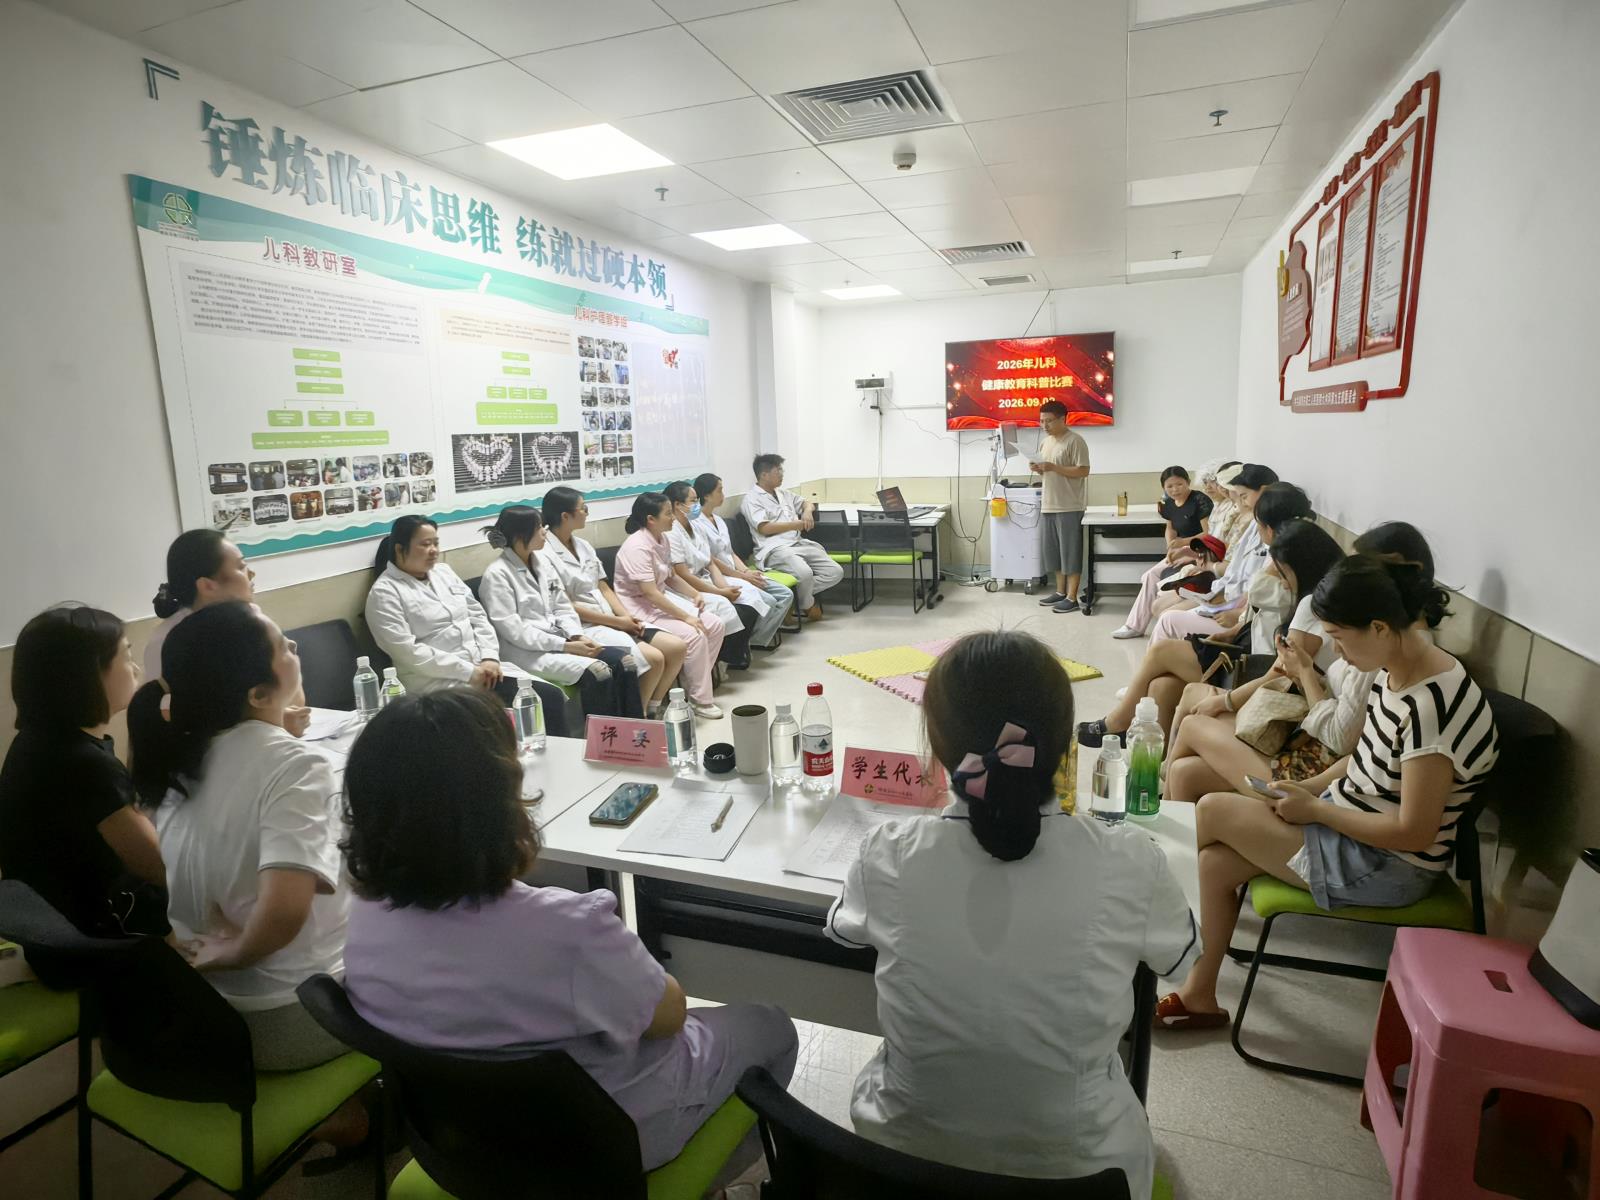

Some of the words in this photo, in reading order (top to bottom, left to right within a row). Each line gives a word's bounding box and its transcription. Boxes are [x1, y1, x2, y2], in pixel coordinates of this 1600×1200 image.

[201, 101, 501, 254] 锤炼临床思维
[516, 216, 667, 300] 练就过硬本领
[263, 236, 357, 276] 儿科教研室
[997, 356, 1057, 370] 2026年儿科
[981, 375, 1073, 391] 健康教育科普比赛
